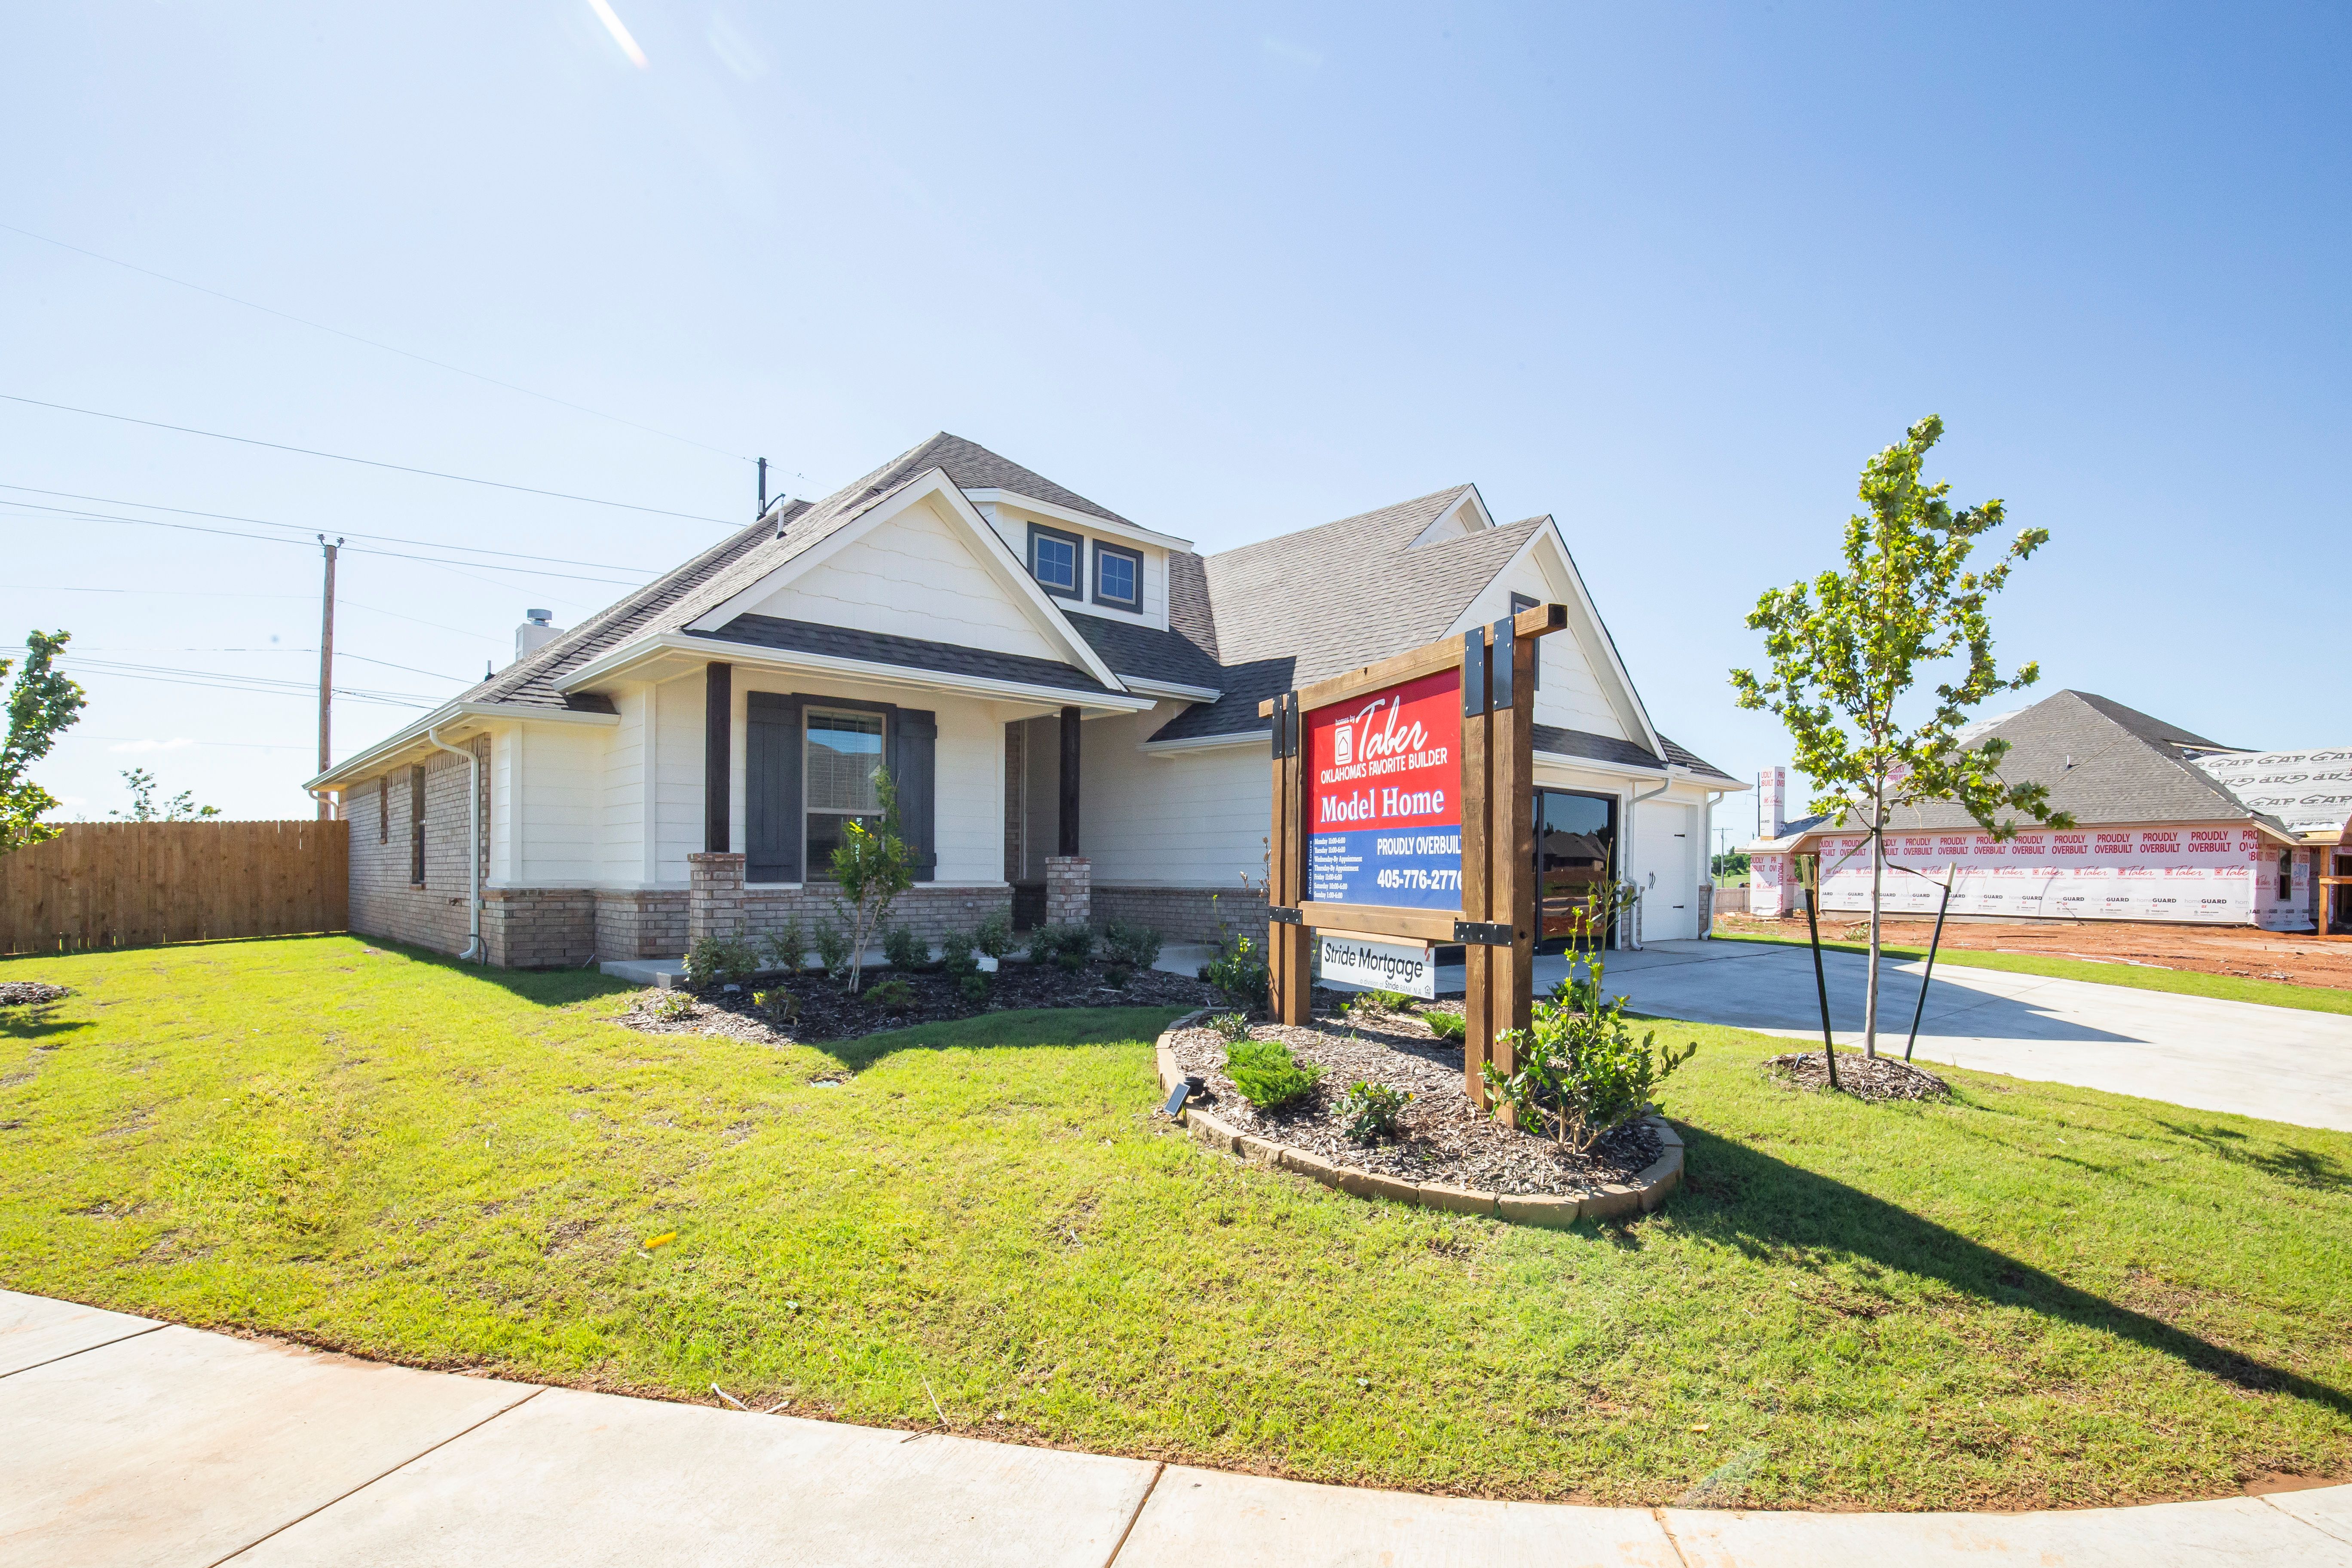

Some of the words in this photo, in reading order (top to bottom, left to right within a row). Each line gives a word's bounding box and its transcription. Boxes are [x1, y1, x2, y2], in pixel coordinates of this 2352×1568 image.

[1335, 717, 1349, 726] homes
[1350, 715, 1355, 724] by
[1356, 695, 1428, 763] Taber
[1321, 763, 1367, 784] OKLAHOMA'S
[1369, 755, 1406, 776] FAVORITE
[1409, 747, 1448, 770] BUILDER
[1320, 787, 1375, 823] Model
[1381, 787, 1445, 818] Home
[1940, 837, 1967, 845] PROUDLY
[2014, 836, 2044, 844] PROUDLY
[2055, 835, 2086, 844] PROUDLY
[2097, 833, 2130, 843] PROUDLY
[2143, 832, 2178, 842] PROUDLY
[2191, 831, 2228, 841] PROUDLY
[1377, 837, 1415, 855] PROUDLY
[1416, 835, 1461, 855] OVERBUIL
[1905, 838, 1931, 846] PROUDLY
[2188, 842, 2231, 852] OVERBUILT
[1904, 847, 1933, 855] OVERBUILT
[1938, 846, 1969, 855] OVERBUILT
[1974, 846, 2006, 854] OVERBUILT
[2012, 845, 2046, 854] OVERBUILT
[2052, 845, 2088, 854] OVERBUILT
[2095, 844, 2133, 854] OVERBUILT
[2140, 843, 2180, 853] OVERBUILT
[1339, 855, 1363, 864] Appointment
[1929, 866, 1948, 875] Taber
[1964, 865, 1985, 875] Taber
[2001, 866, 2024, 875] Taber
[2042, 866, 2065, 876] Taber
[2083, 866, 2108, 876] Taber
[2128, 865, 2154, 876] Taber
[2175, 865, 2203, 876] Taber
[1314, 891, 1326, 899] Sunday
[1325, 943, 1356, 966] Stride
[1359, 947, 1423, 983] Mortgage
[1363, 979, 1378, 987] division
[1385, 980, 1399, 990] Stride
